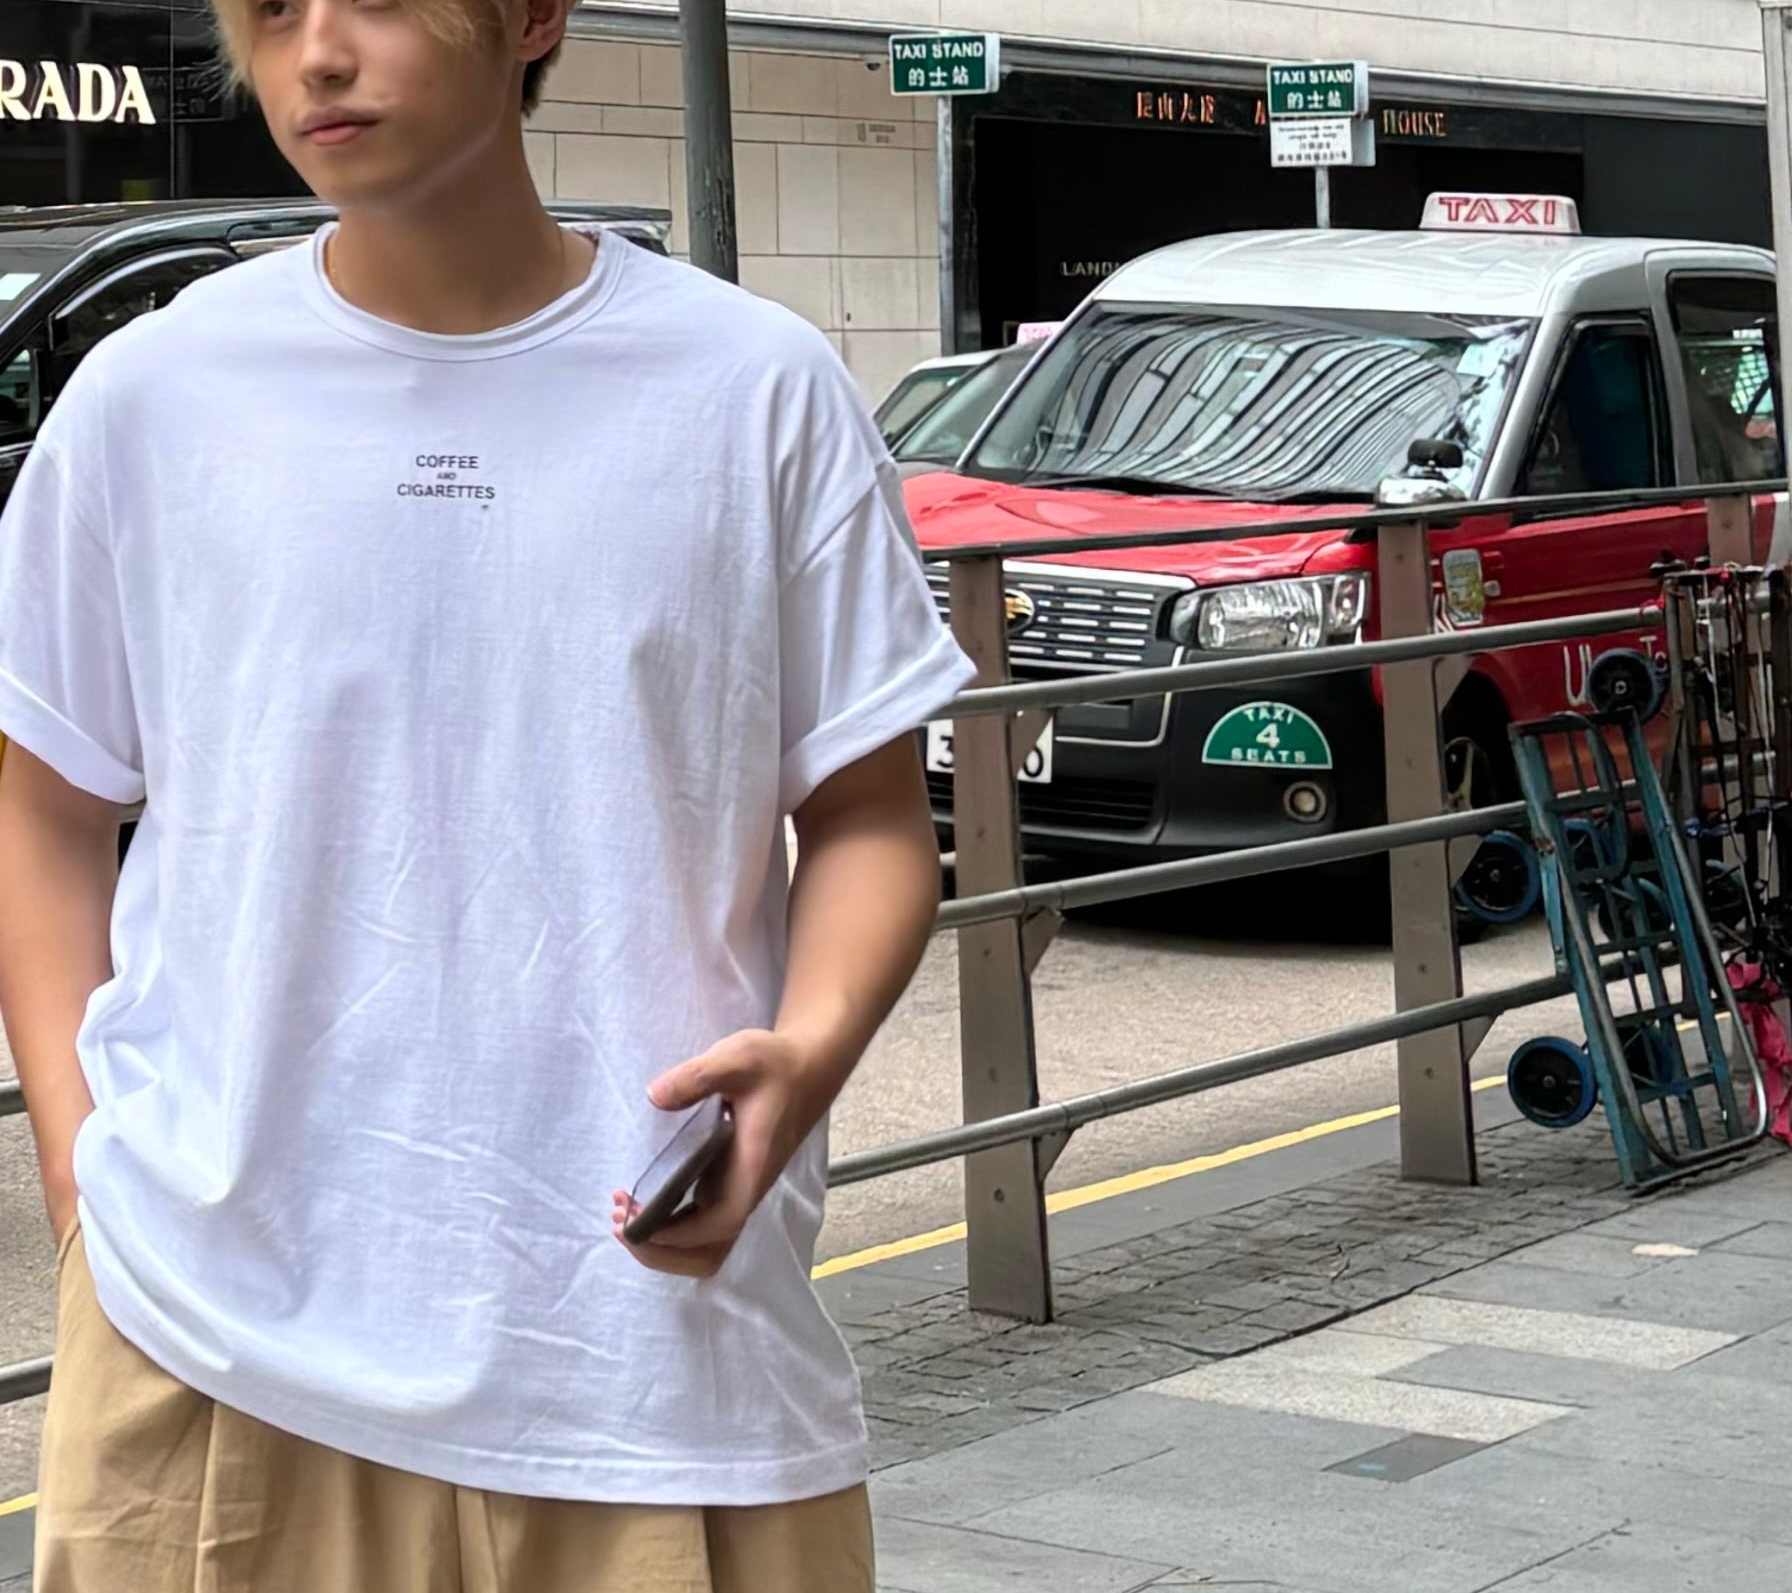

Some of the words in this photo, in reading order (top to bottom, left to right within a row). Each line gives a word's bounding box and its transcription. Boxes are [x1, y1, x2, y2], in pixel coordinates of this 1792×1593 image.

[893, 44, 926, 60] TAXI
[932, 41, 984, 59] STAND
[908, 65, 969, 87] 的士站
[1272, 70, 1306, 85] TAXI
[1309, 68, 1353, 84] STAND
[1439, 196, 1557, 225] TAXI
[1061, 261, 1120, 277] LAND
[415, 455, 479, 469] COFFEE
[397, 483, 496, 499] CIGARETTES
[1242, 707, 1295, 724] TAXI
[1256, 723, 1280, 748] 4
